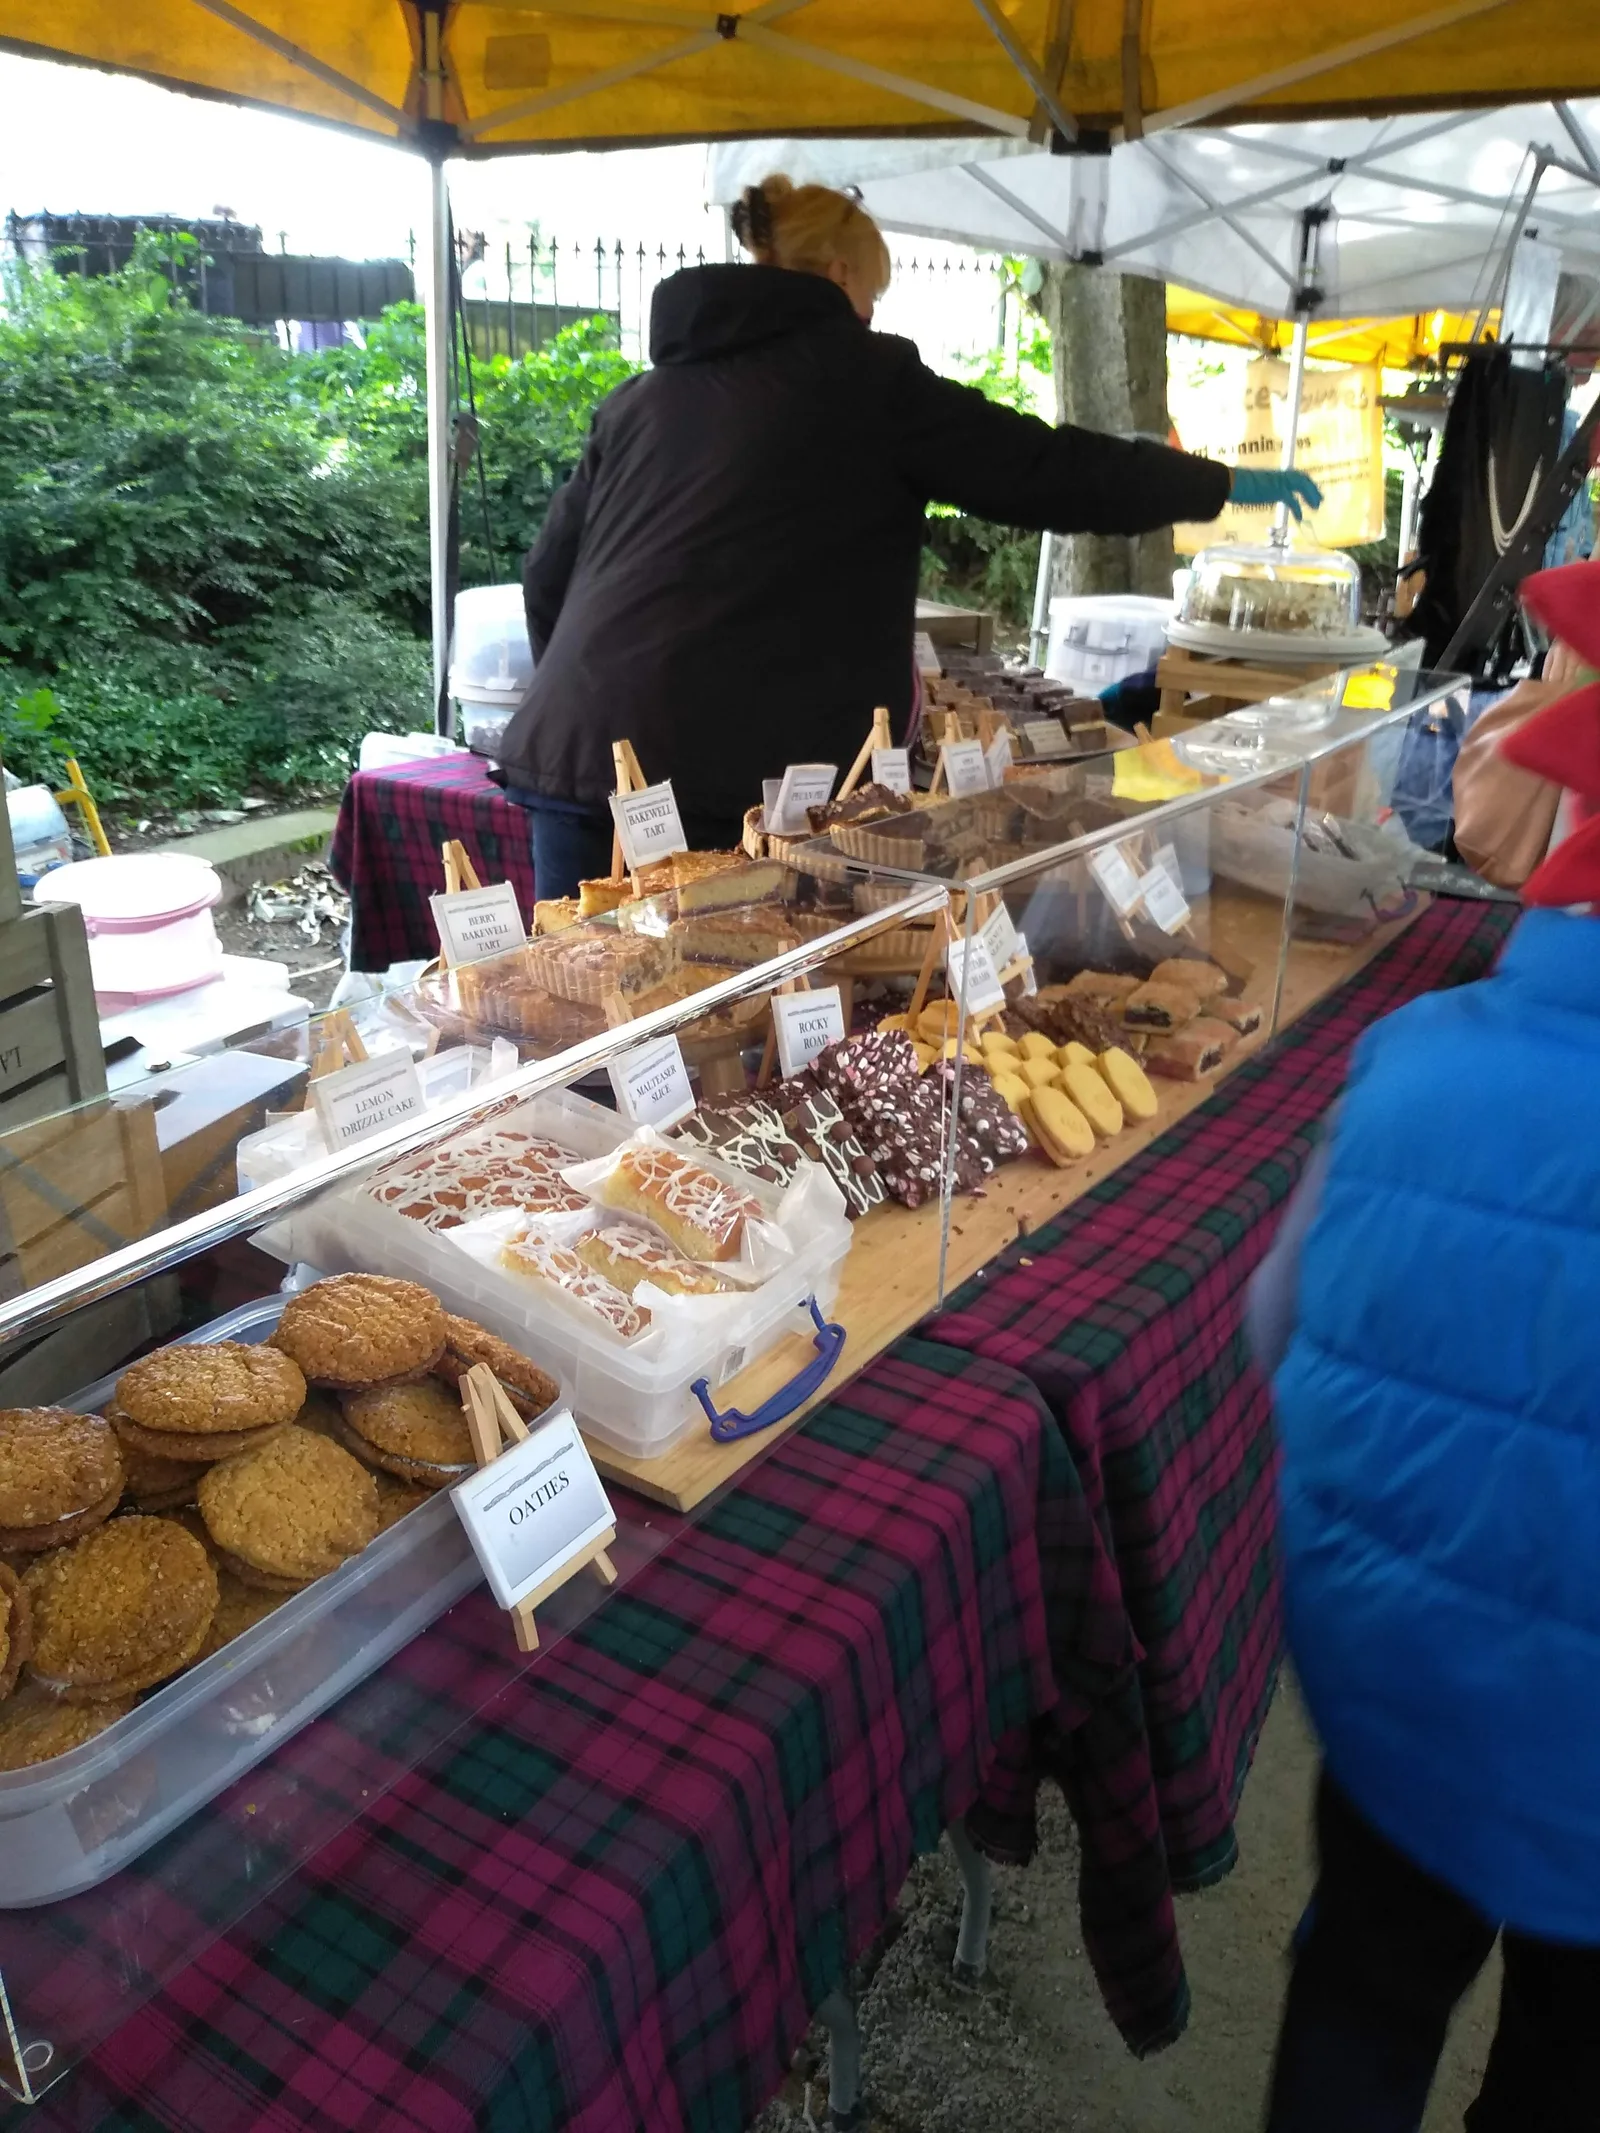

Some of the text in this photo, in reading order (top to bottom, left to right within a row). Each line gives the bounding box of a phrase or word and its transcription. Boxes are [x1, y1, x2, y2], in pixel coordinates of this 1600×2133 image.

[628, 804, 673, 826] BAKEWELL
[643, 823, 666, 838] TART
[468, 913, 497, 926] BERRY
[461, 924, 510, 942] BAKEWELL
[477, 940, 501, 952] TART
[798, 1017, 828, 1034] ROCKY
[803, 1034, 829, 1050] ROAD
[636, 1064, 677, 1097] MALTEASER
[355, 1088, 394, 1114] LEMON
[651, 1084, 671, 1103] SLICE
[341, 1096, 416, 1137] DRIZZLE CAKE
[508, 1470, 571, 1526] OATIES
